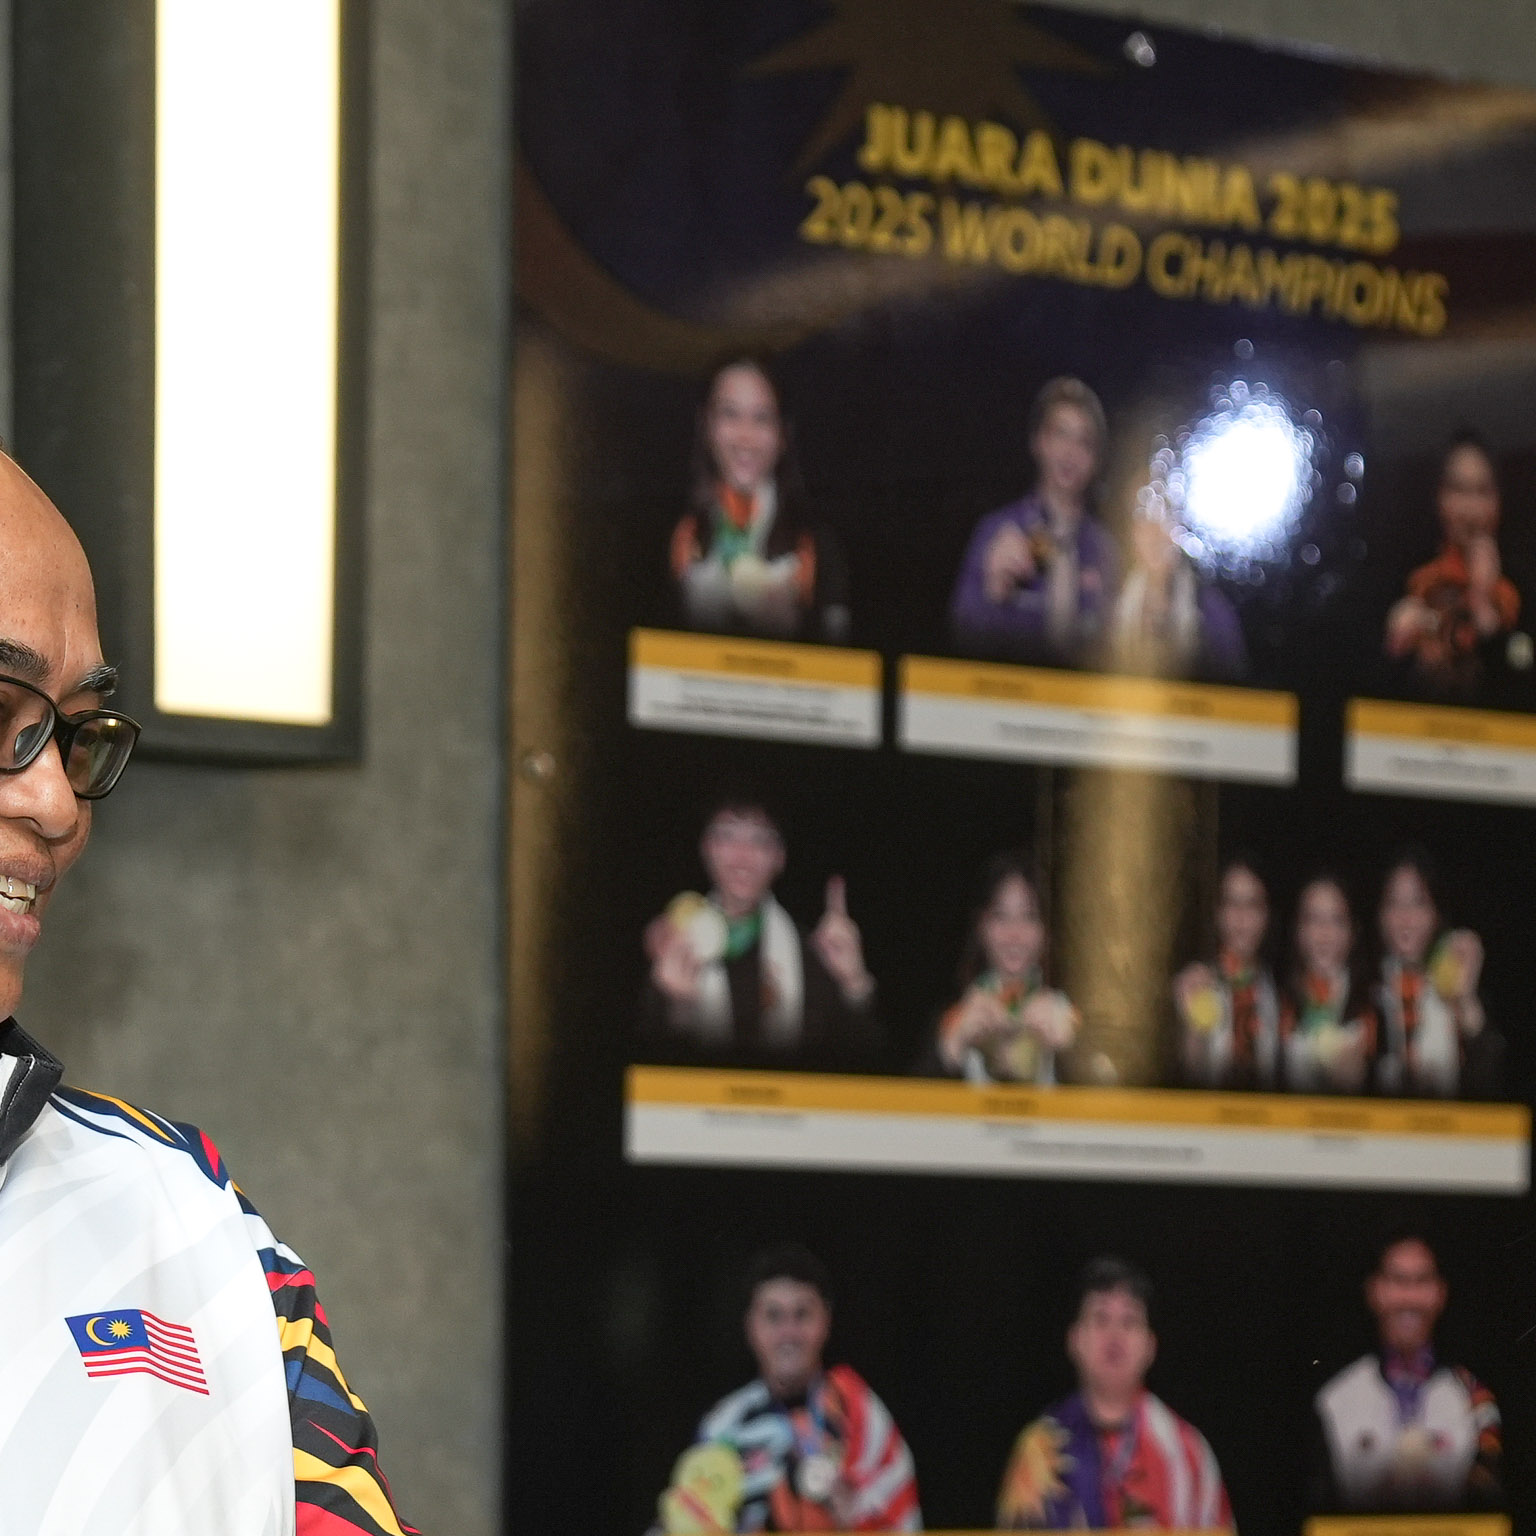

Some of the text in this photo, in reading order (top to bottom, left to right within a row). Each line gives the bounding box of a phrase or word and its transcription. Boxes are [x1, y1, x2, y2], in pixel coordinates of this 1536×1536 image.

[800, 174, 1449, 336] 2025 WORLD CHAMPIONS
[860, 103, 1399, 253] JUARA DUNIA 2025
